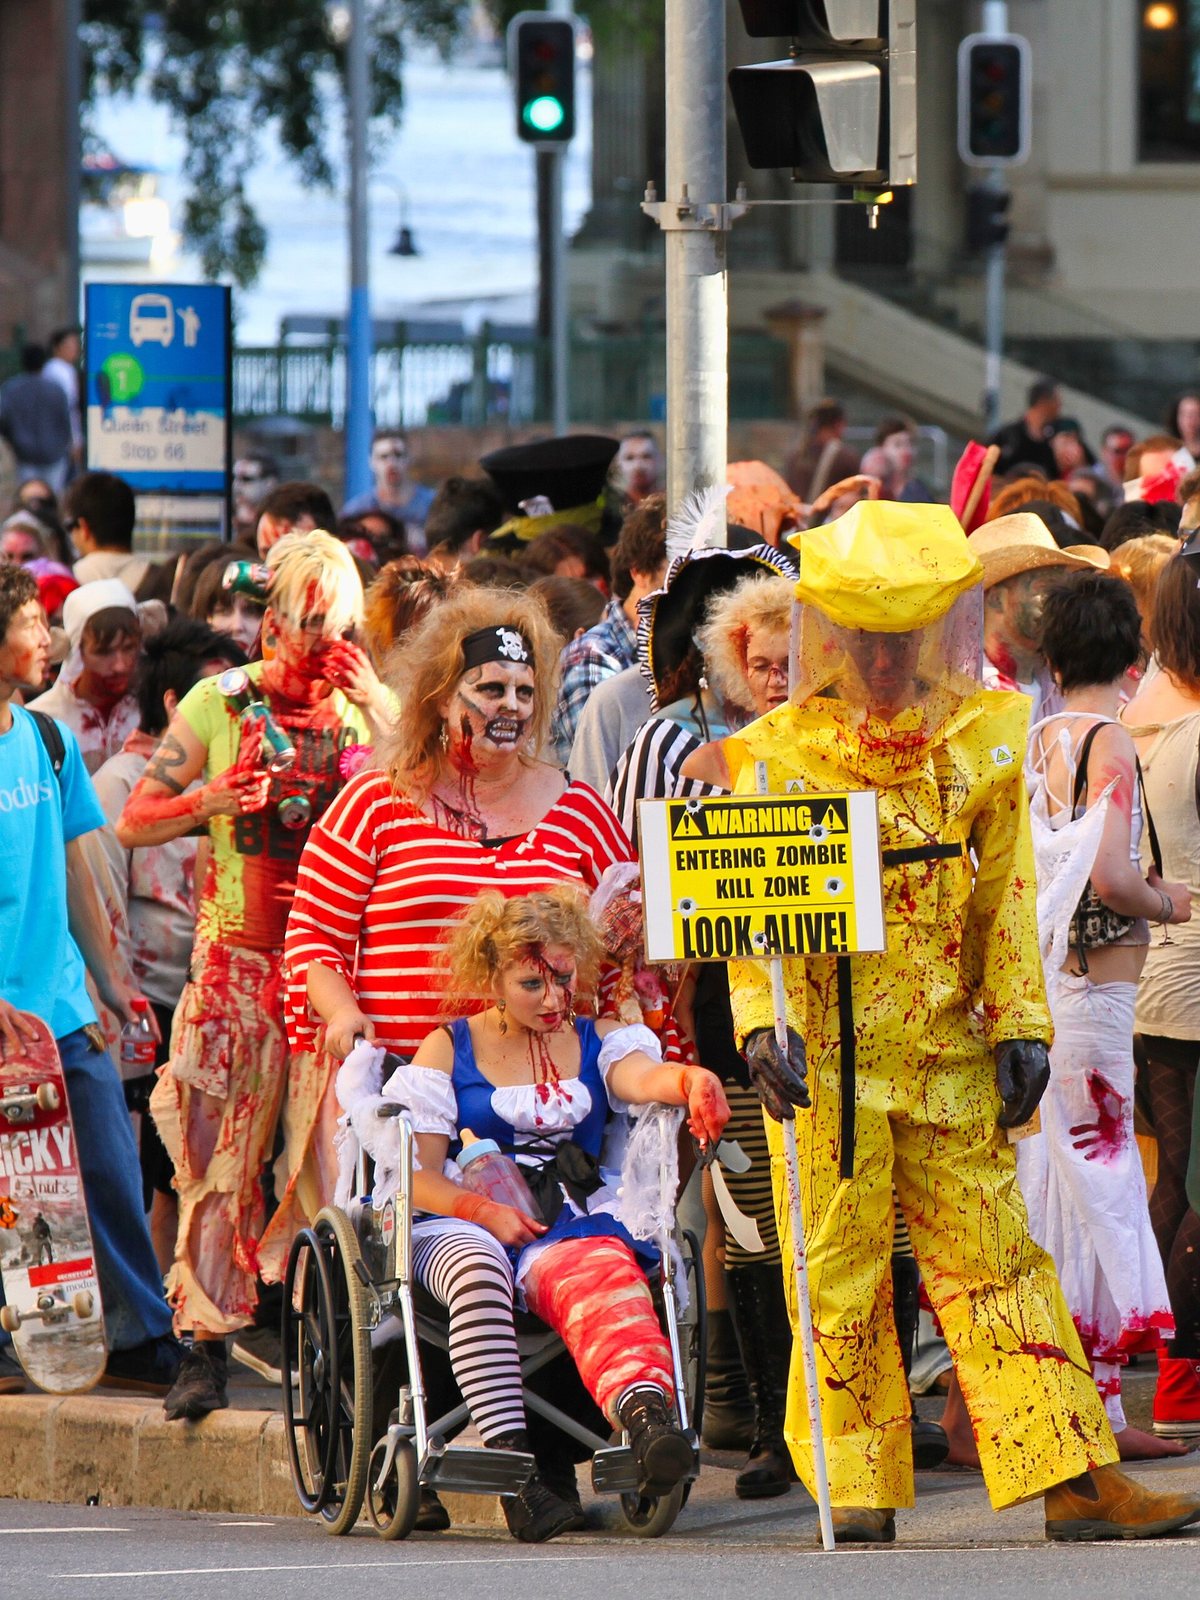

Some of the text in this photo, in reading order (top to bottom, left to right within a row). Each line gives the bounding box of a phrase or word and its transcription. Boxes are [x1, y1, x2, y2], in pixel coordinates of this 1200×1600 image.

[159, 414, 207, 434] Street
[121, 441, 156, 461] Stop
[705, 805, 813, 835] WARNING
[676, 844, 847, 871] ENTERING ZOMBIE
[716, 875, 811, 900] KILL ZONE
[682, 911, 848, 959] LOOK ALIVE!
